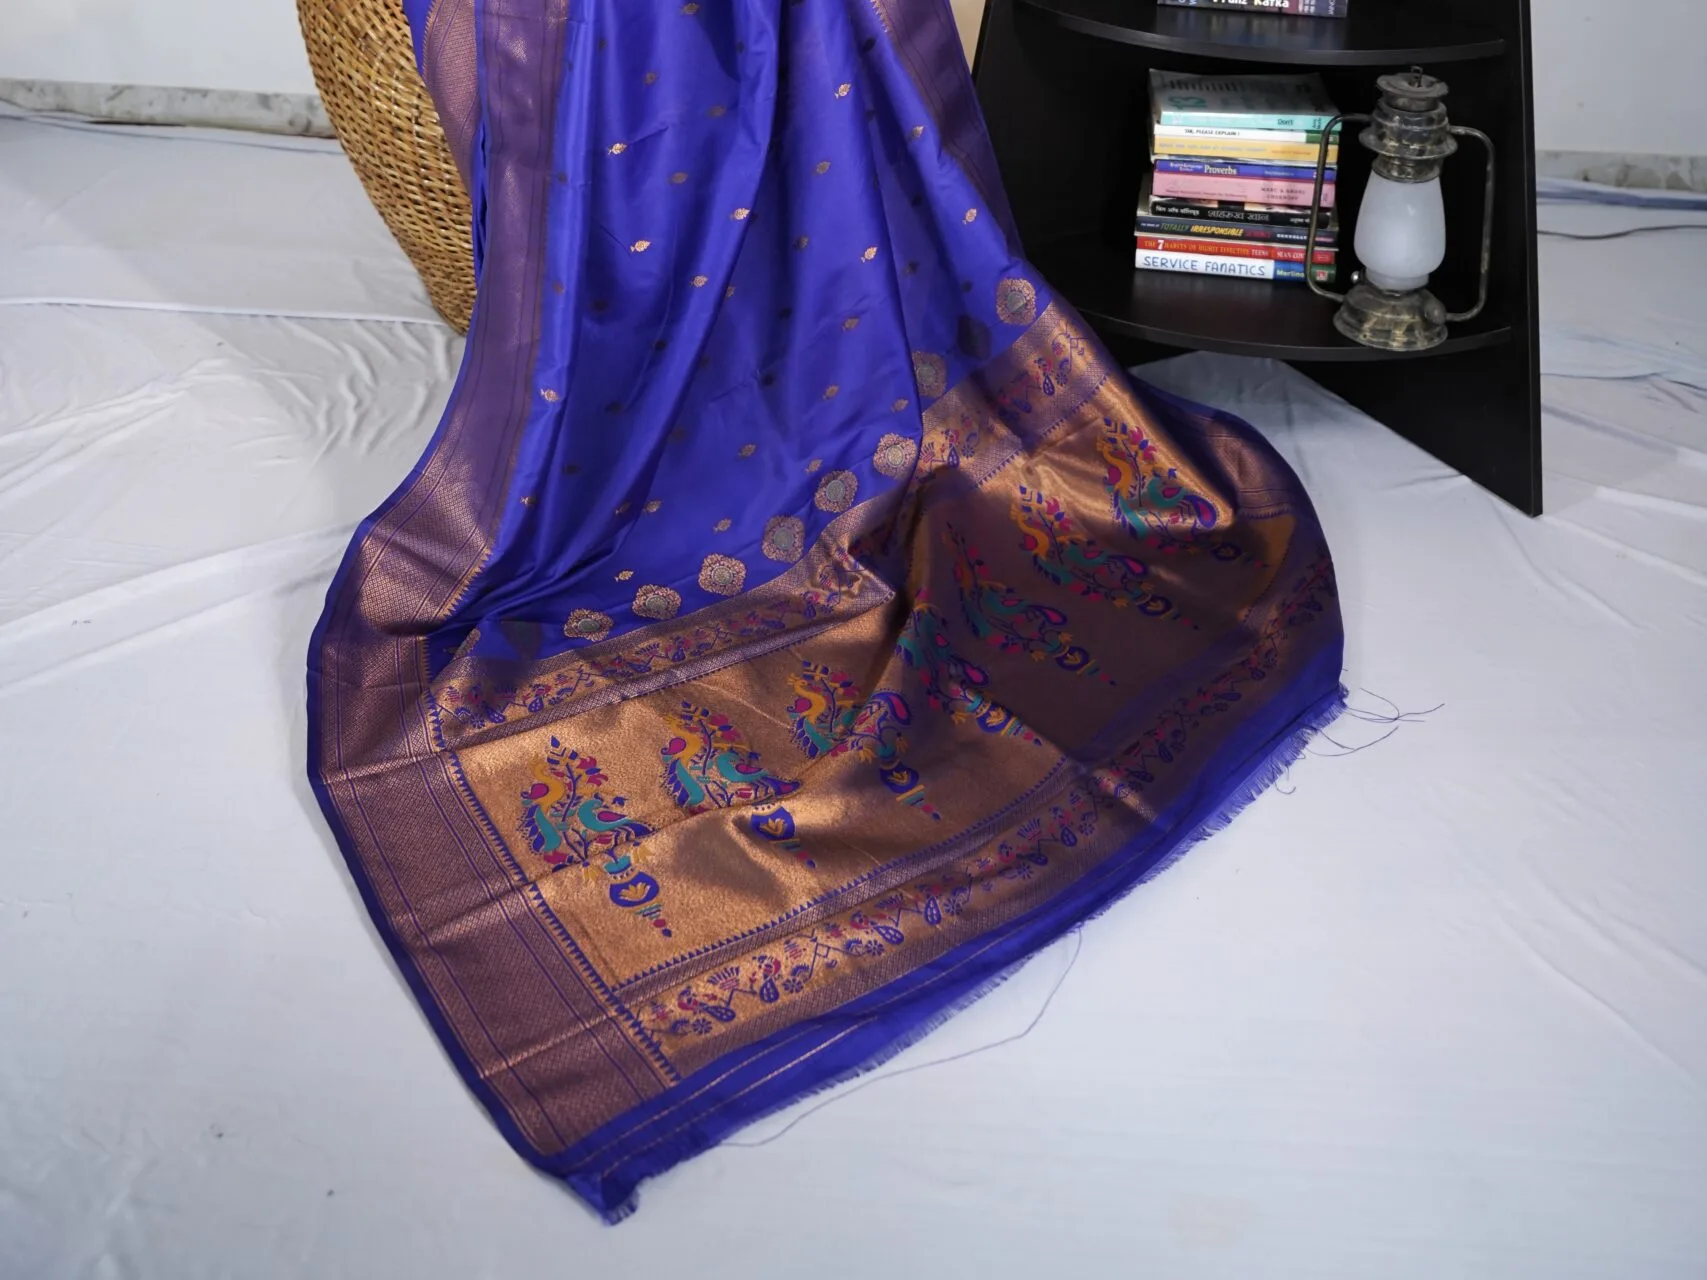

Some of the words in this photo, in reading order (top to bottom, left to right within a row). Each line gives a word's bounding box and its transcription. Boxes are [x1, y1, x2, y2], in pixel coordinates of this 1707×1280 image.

[1204, 164, 1237, 175] Proverbs
[1161, 222, 1190, 231] TOTALLY
[1190, 225, 1244, 236] IRRESPONSIBLE
[1157, 240, 1164, 249] 7
[1144, 256, 1198, 270] SERVICE
[1205, 261, 1265, 275] FANATICS
